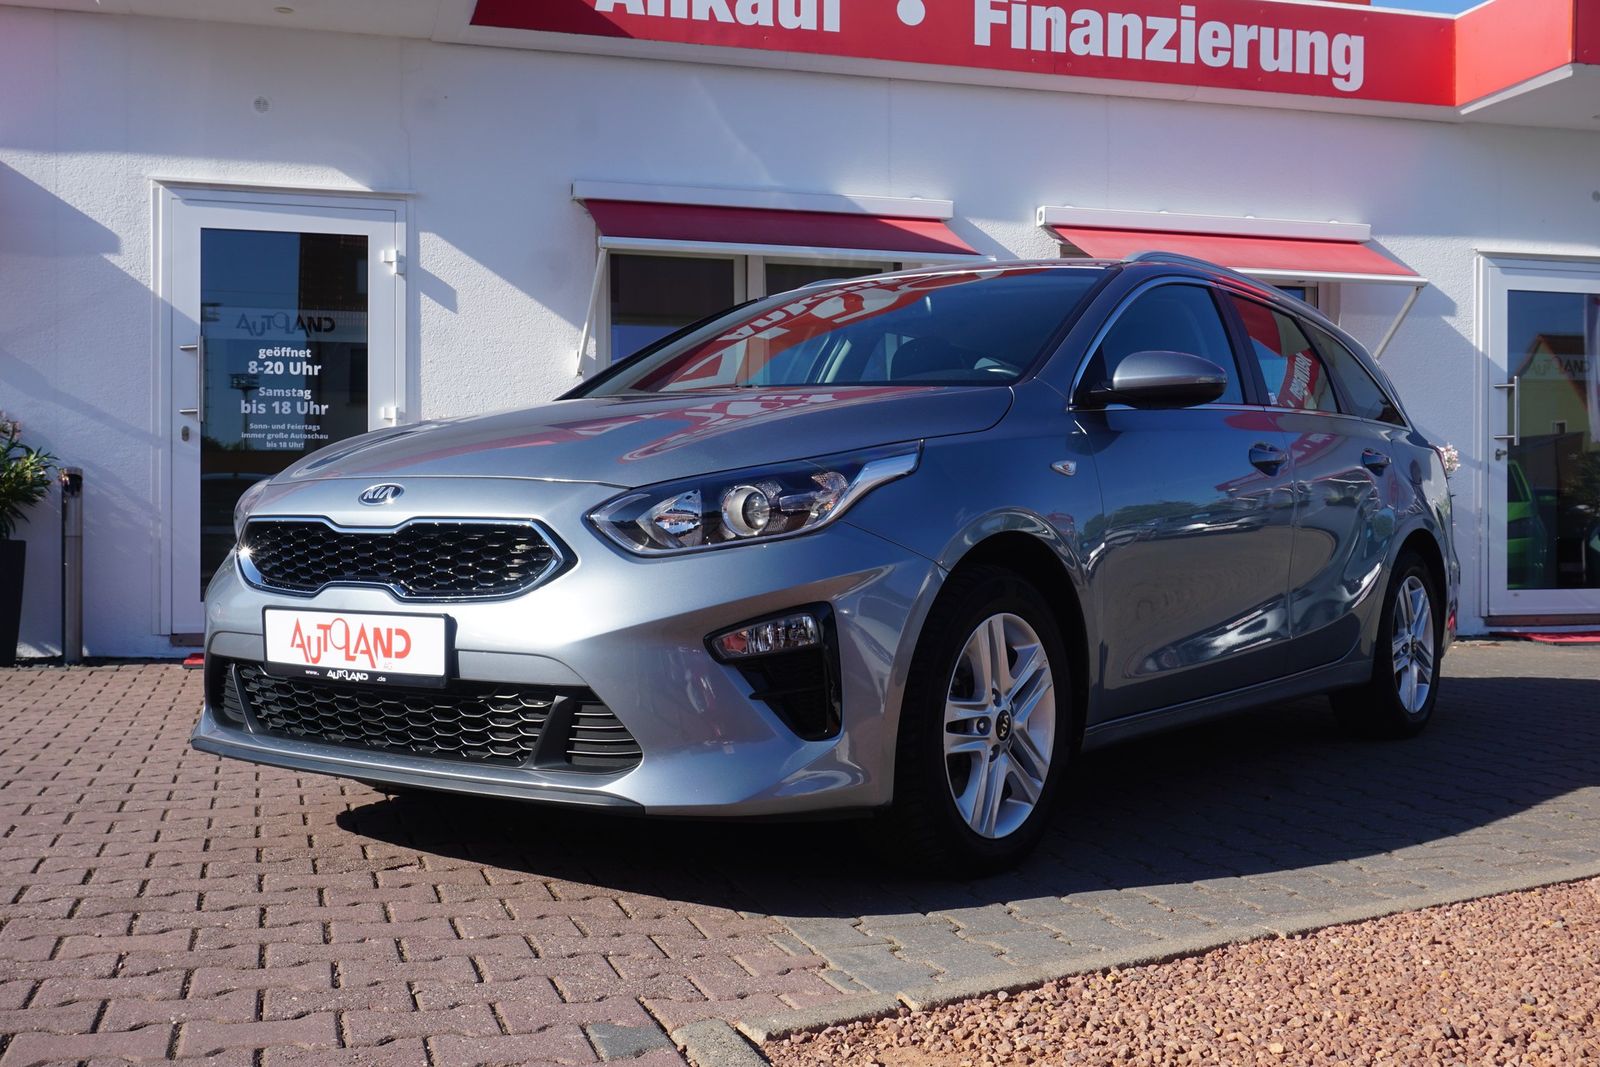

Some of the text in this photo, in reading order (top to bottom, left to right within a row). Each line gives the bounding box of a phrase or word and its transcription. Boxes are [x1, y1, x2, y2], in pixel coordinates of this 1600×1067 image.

[974, 0, 1365, 92] Finanzierung
[258, 347, 311, 359] geöffnet
[248, 361, 321, 375] 8-20 Uhr
[258, 387, 311, 399] Samstag
[240, 400, 328, 415] bis 18 Uhr
[363, 486, 395, 499] KIA
